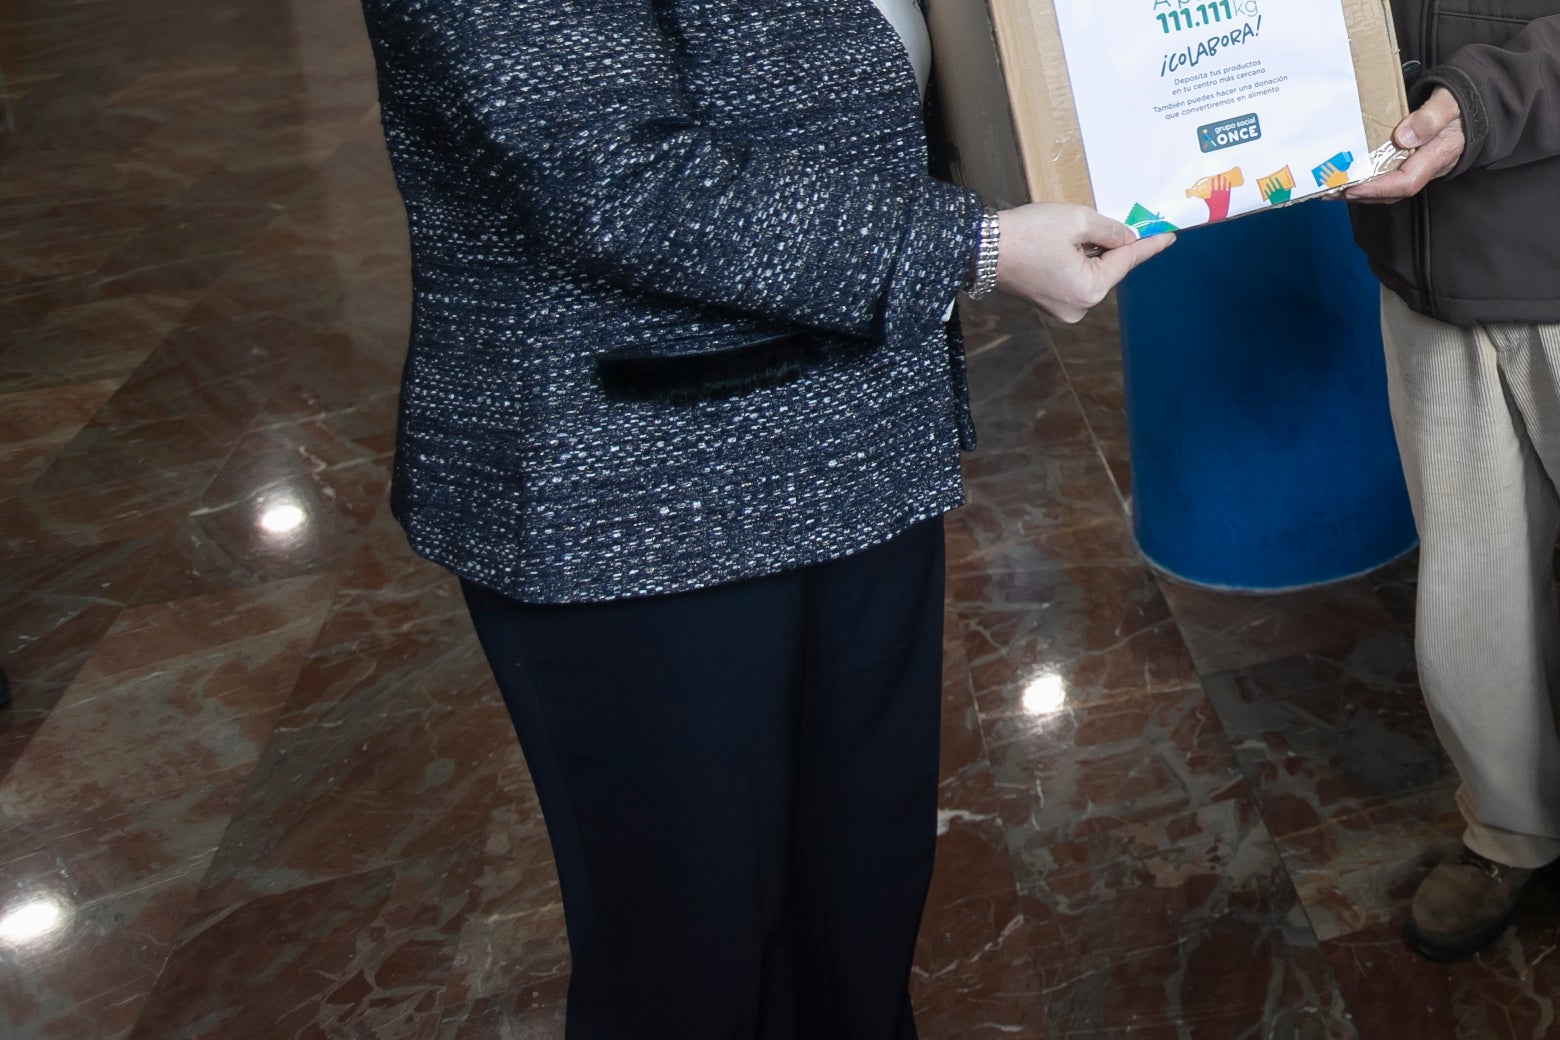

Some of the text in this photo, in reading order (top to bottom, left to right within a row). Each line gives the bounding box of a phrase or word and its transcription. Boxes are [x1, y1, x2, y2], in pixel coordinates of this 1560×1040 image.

[1174, 72, 1208, 85] Deposita
[1223, 60, 1261, 74] productos
[1193, 80, 1217, 90] centro
[1220, 75, 1234, 83] más
[1237, 68, 1266, 79] cercano
[1153, 75, 1288, 113] También puedes hacer una donación
[1165, 112, 1179, 120] que
[1182, 98, 1235, 116] convertiremos
[1248, 86, 1280, 99] alimento
[1214, 117, 1256, 134] grupo social
[1217, 125, 1258, 145] ONCE
